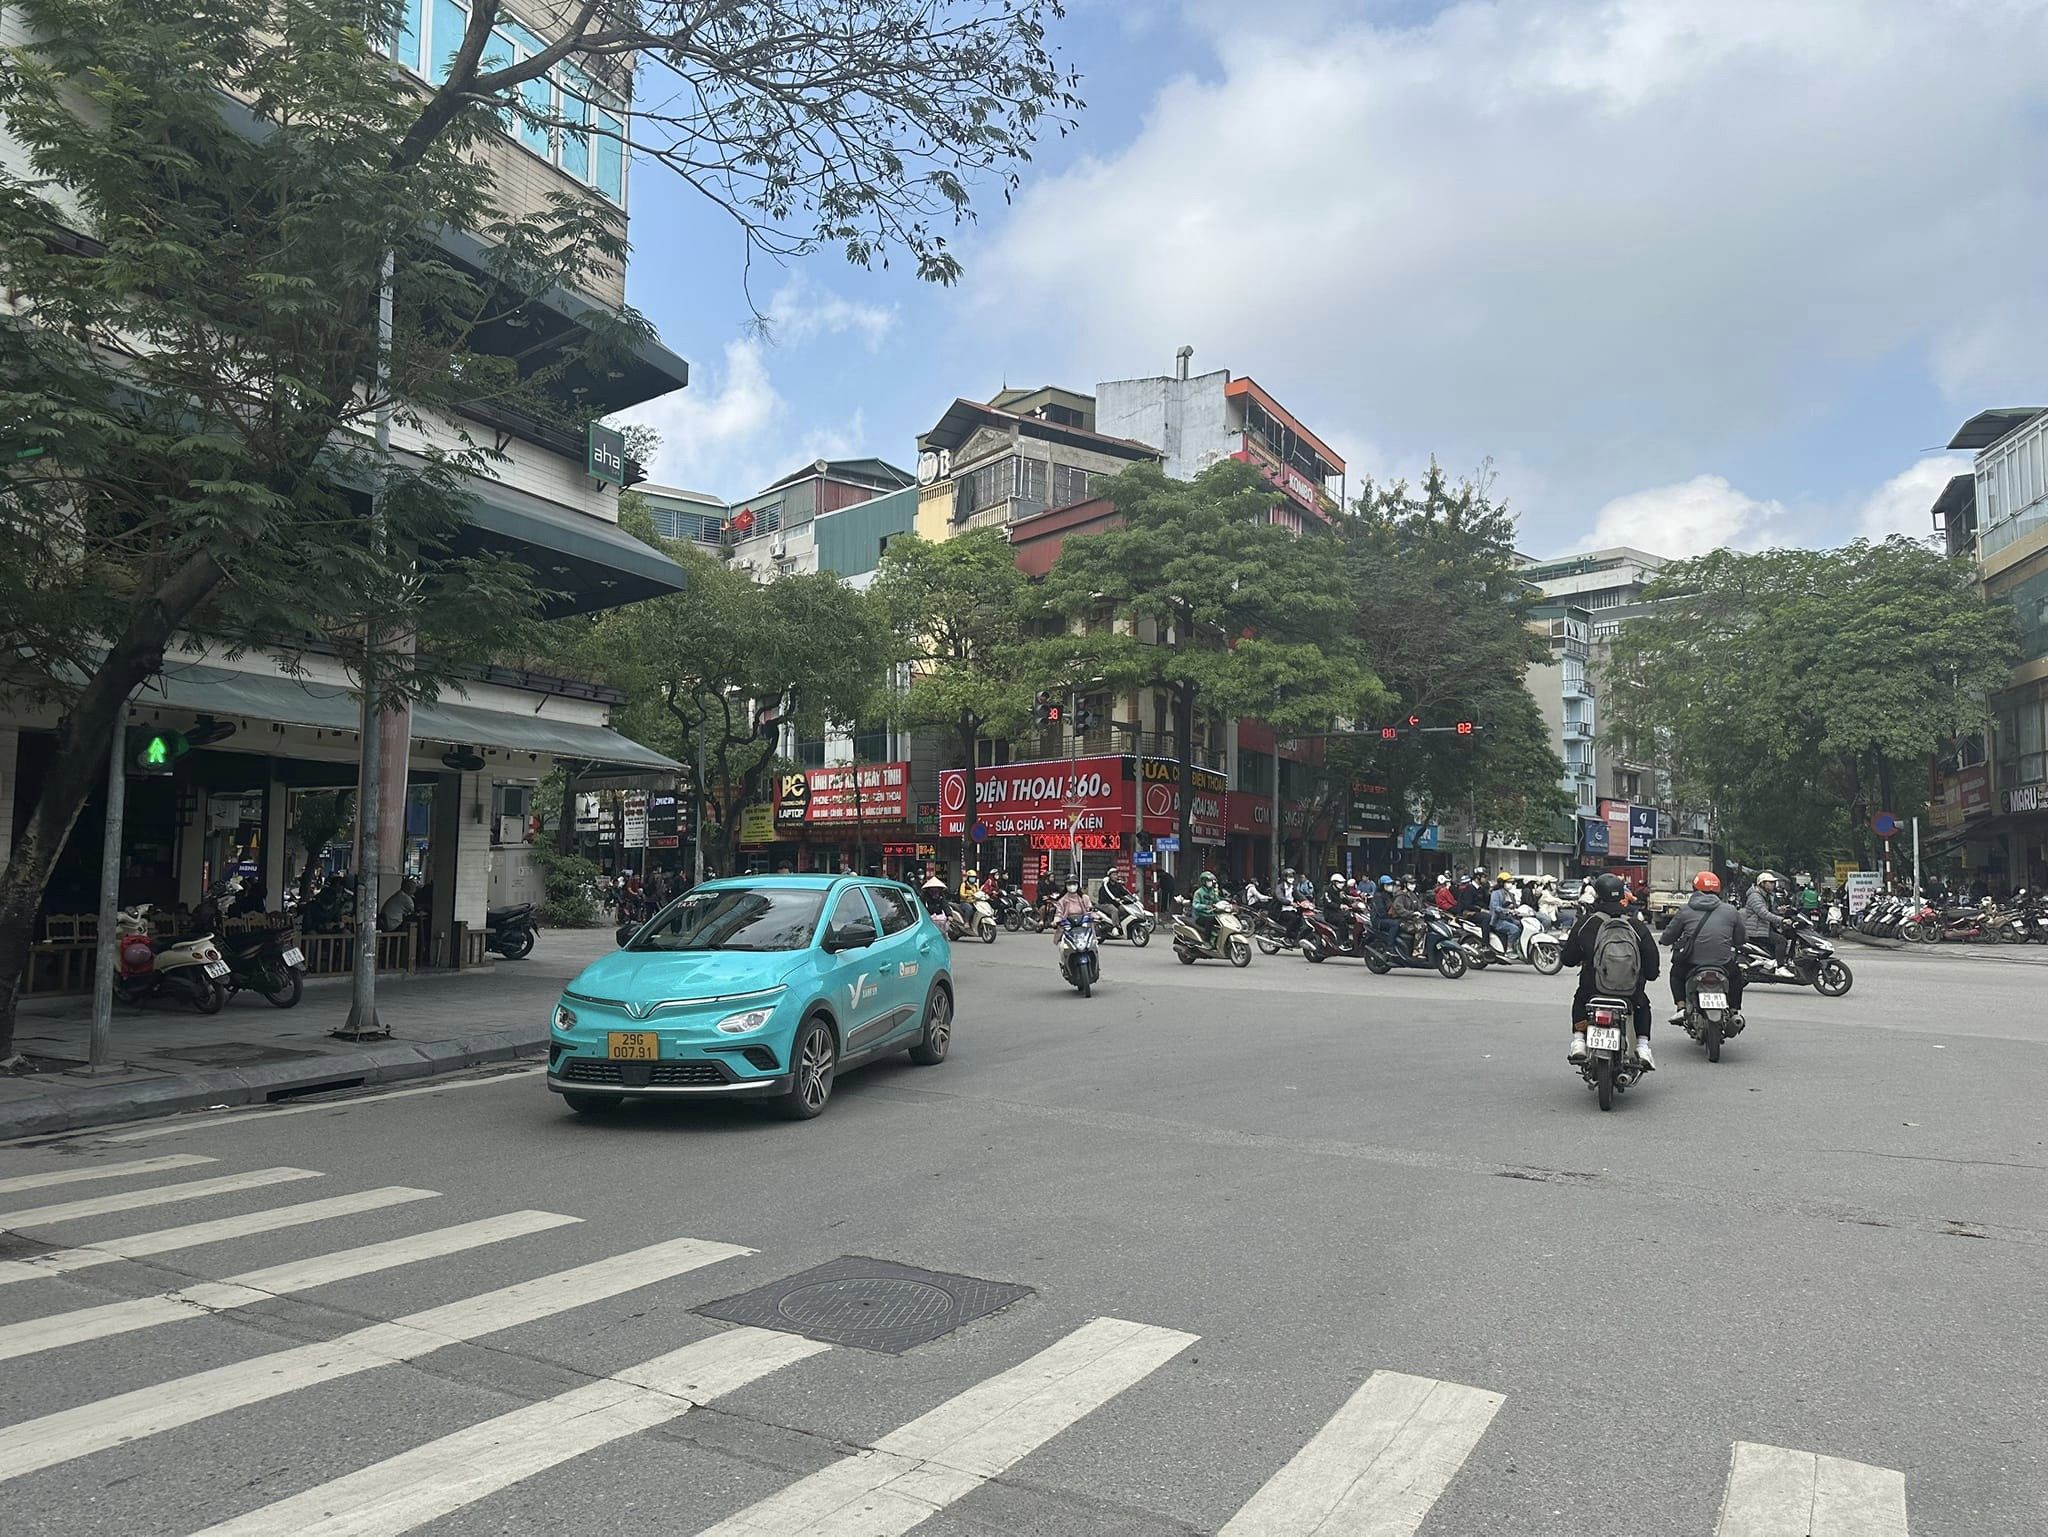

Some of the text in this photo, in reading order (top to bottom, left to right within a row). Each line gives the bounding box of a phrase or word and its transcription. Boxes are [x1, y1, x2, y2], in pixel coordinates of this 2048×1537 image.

[594, 444, 621, 470] aha
[975, 776, 1008, 808] ĐIỆN
[1066, 773, 1101, 798] 360
[2010, 787, 2038, 812] MARU
[779, 808, 804, 819] LAPTOP
[995, 815, 1015, 832] SỬA
[1017, 815, 1044, 831] CHỮA
[1078, 813, 1103, 830] KIỆN
[622, 1033, 644, 1046] 29G
[613, 1046, 652, 1058] 007.91
